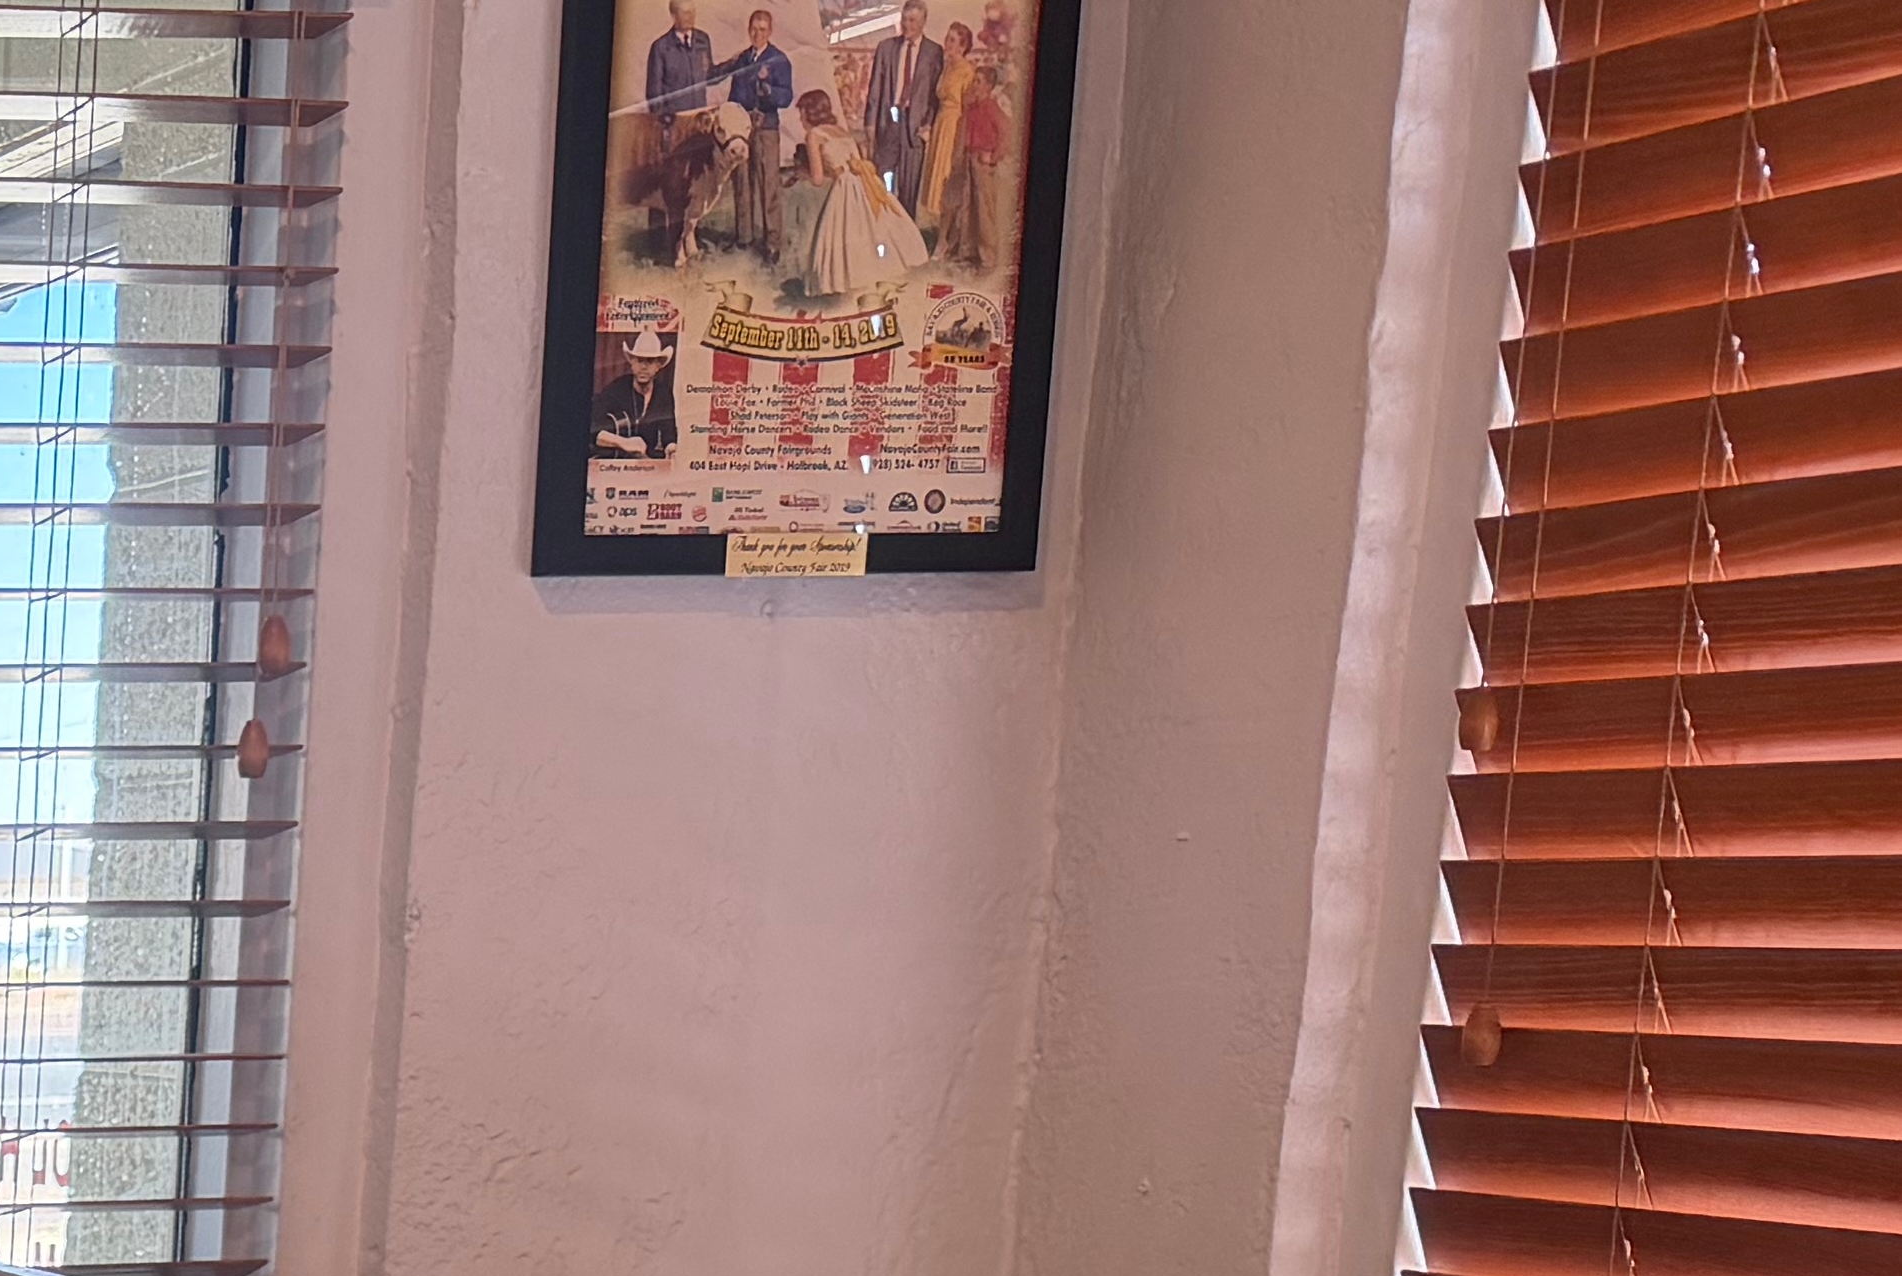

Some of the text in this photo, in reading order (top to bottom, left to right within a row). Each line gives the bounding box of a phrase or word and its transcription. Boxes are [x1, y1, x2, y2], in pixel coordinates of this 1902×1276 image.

[709, 313, 784, 350] September
[786, 326, 820, 350] 11th
[833, 324, 857, 348] 14,
[686, 384, 733, 393] Demolition
[735, 384, 761, 395] Derby
[809, 384, 845, 393] Carnival
[821, 411, 839, 420] with
[689, 424, 728, 435] Standing
[730, 424, 756, 433] Horse
[803, 424, 830, 433] Rodeo
[832, 424, 859, 433] Dance
[941, 424, 957, 433] and
[709, 445, 832, 457] Navajo County Fairgrounds
[708, 461, 727, 470] East
[729, 461, 751, 472] Hopi
[753, 461, 778, 470] Drive
[786, 460, 831, 471] Holbrook,
[619, 506, 637, 517] aps
[741, 562, 851, 576] Navajo County Fair 2019
